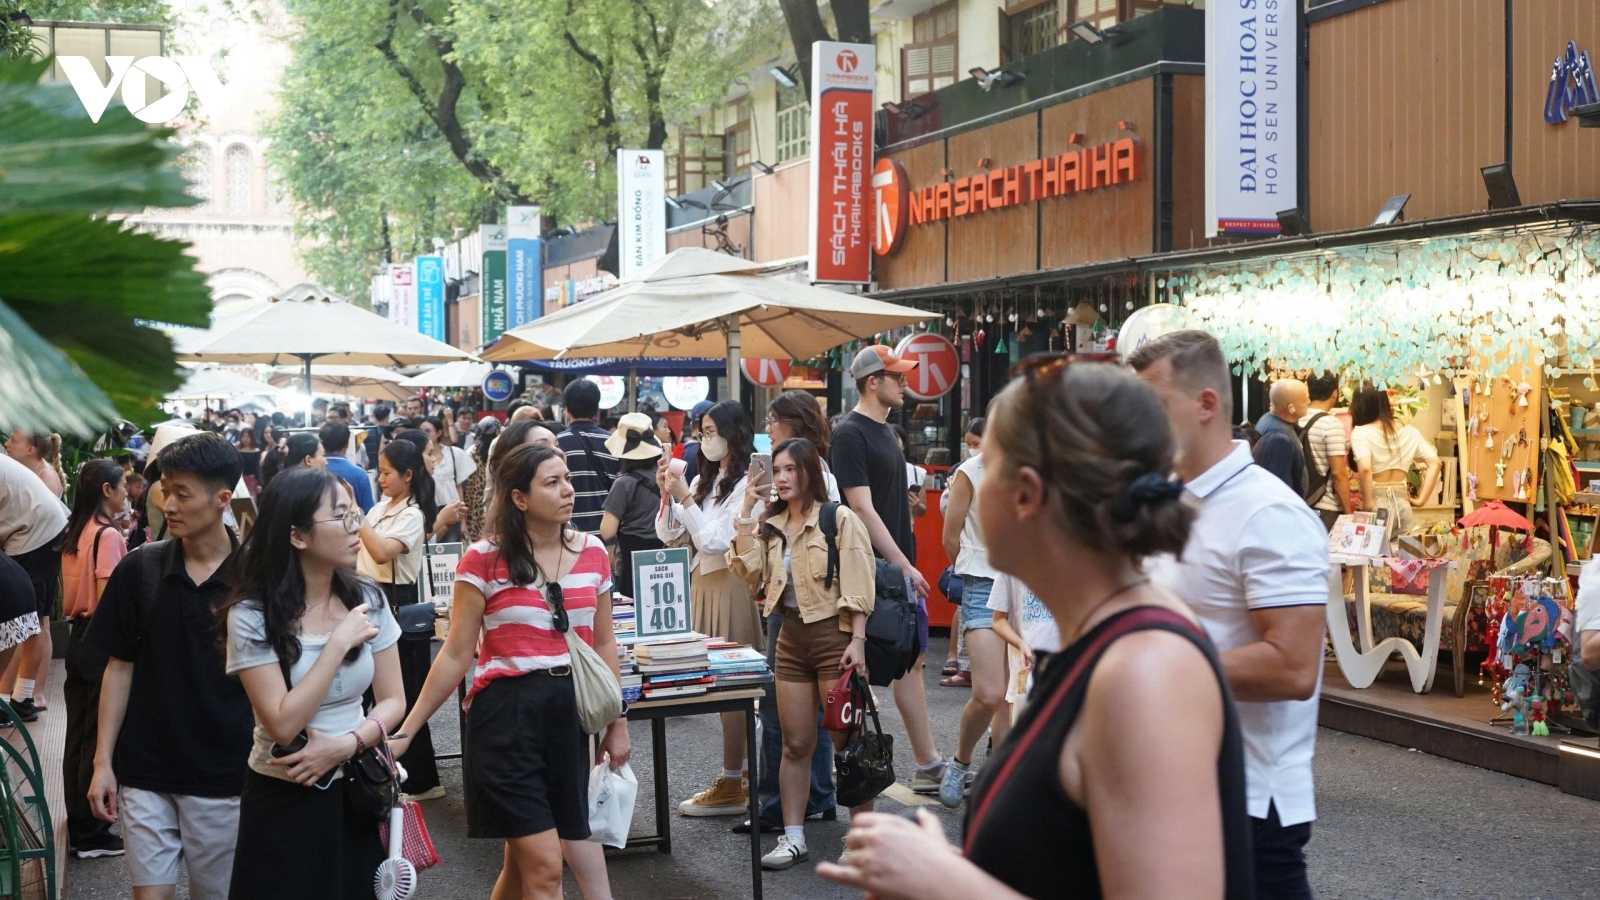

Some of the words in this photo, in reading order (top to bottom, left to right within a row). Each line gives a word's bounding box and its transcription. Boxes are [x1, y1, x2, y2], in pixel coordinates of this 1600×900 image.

[1239, 15, 1257, 75] HOA
[1265, 0, 1278, 90] UNIVERS
[831, 100, 849, 136] HÀ
[1239, 80, 1259, 141] HỌC
[1265, 102, 1278, 142] SEN
[831, 140, 848, 194] THÁI
[851, 120, 863, 248] THAIHABOOKS
[908, 167, 952, 226] NHÀ
[953, 157, 1020, 217] SÁCH
[1023, 133, 1087, 200] THÁI
[1091, 120, 1135, 188] HÀ
[1239, 147, 1259, 193] ĐẠI
[1265, 153, 1278, 194] HOA
[831, 201, 847, 266] SÁCH
[515, 250, 524, 271] NAM
[493, 279, 504, 304] NAM
[491, 307, 504, 331] NHÃ
[515, 311, 524, 326] CH
[430, 569, 455, 582] HIẾU
[434, 585, 451, 595] NHI
